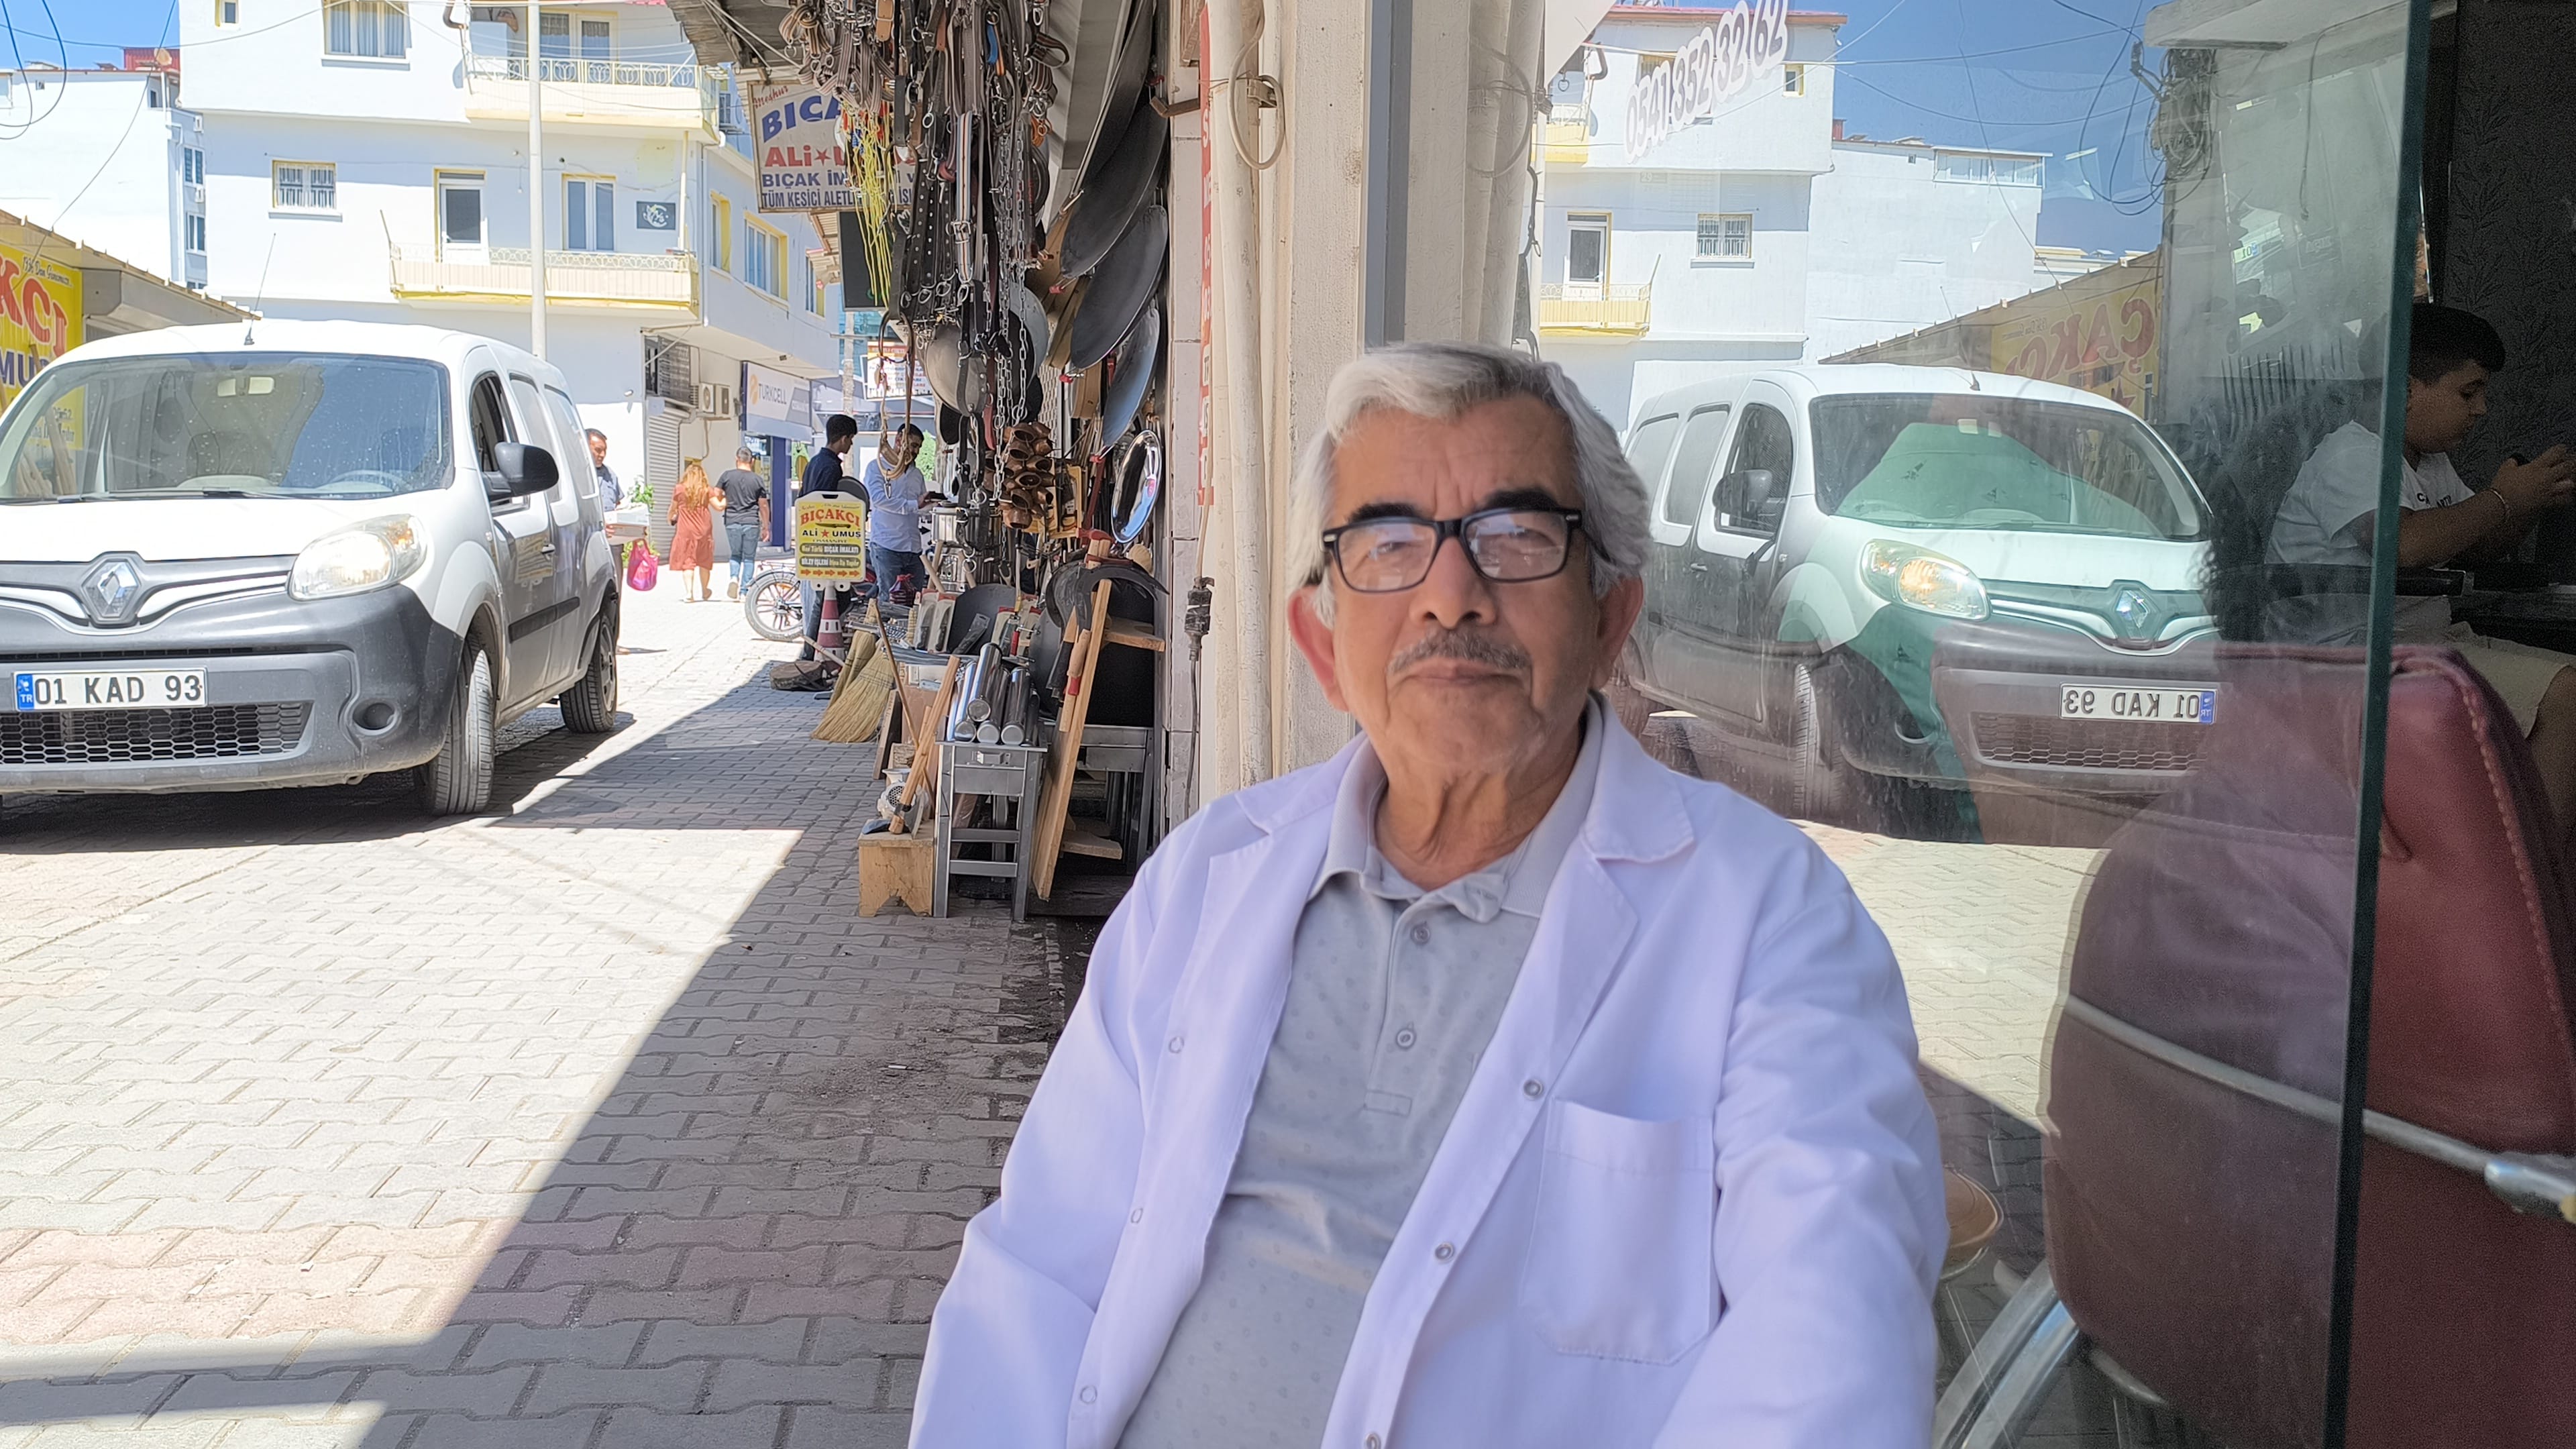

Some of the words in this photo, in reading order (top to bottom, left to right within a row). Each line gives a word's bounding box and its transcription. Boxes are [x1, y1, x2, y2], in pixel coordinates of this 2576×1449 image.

[1715, 8, 1746, 97] 32
[762, 172, 820, 189] BIÇAK
[762, 189, 785, 207] TÜM
[788, 188, 820, 207] KESİCİ
[759, 383, 787, 405] TURKCELL
[802, 528, 818, 536] ALİ
[833, 531, 861, 539] UMUŞ
[20, 694, 32, 702] TR
[34, 678, 67, 704] 01
[85, 676, 144, 704] KAD
[164, 675, 201, 701] 93
